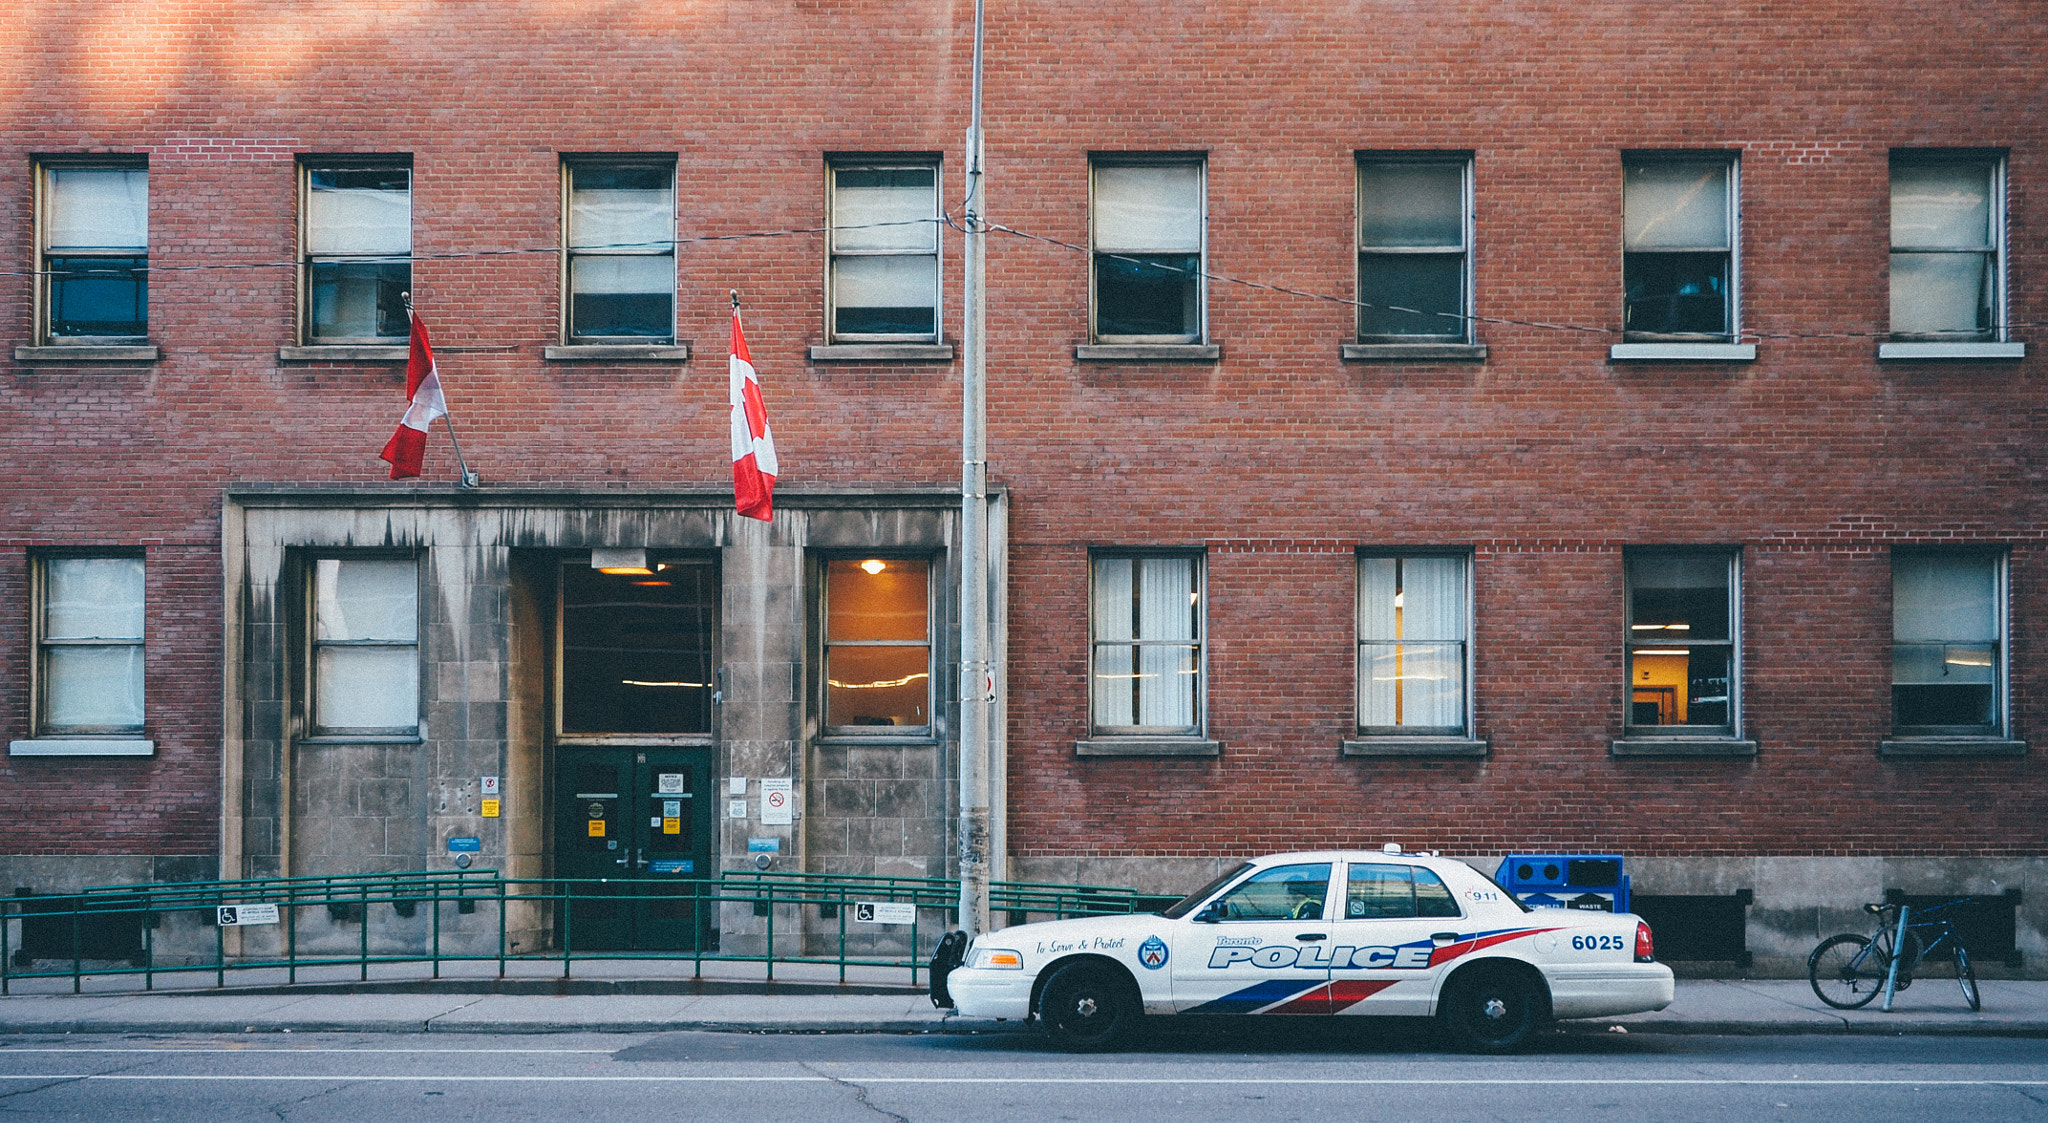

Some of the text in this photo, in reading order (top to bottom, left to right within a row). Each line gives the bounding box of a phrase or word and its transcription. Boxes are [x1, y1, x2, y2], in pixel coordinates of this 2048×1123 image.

[1473, 891, 1498, 901] 911
[1036, 937, 1125, 954] To Serve & Protect
[1216, 936, 1263, 946] Toronto
[1571, 935, 1624, 950] 6025
[1208, 946, 1436, 969] POLICE
